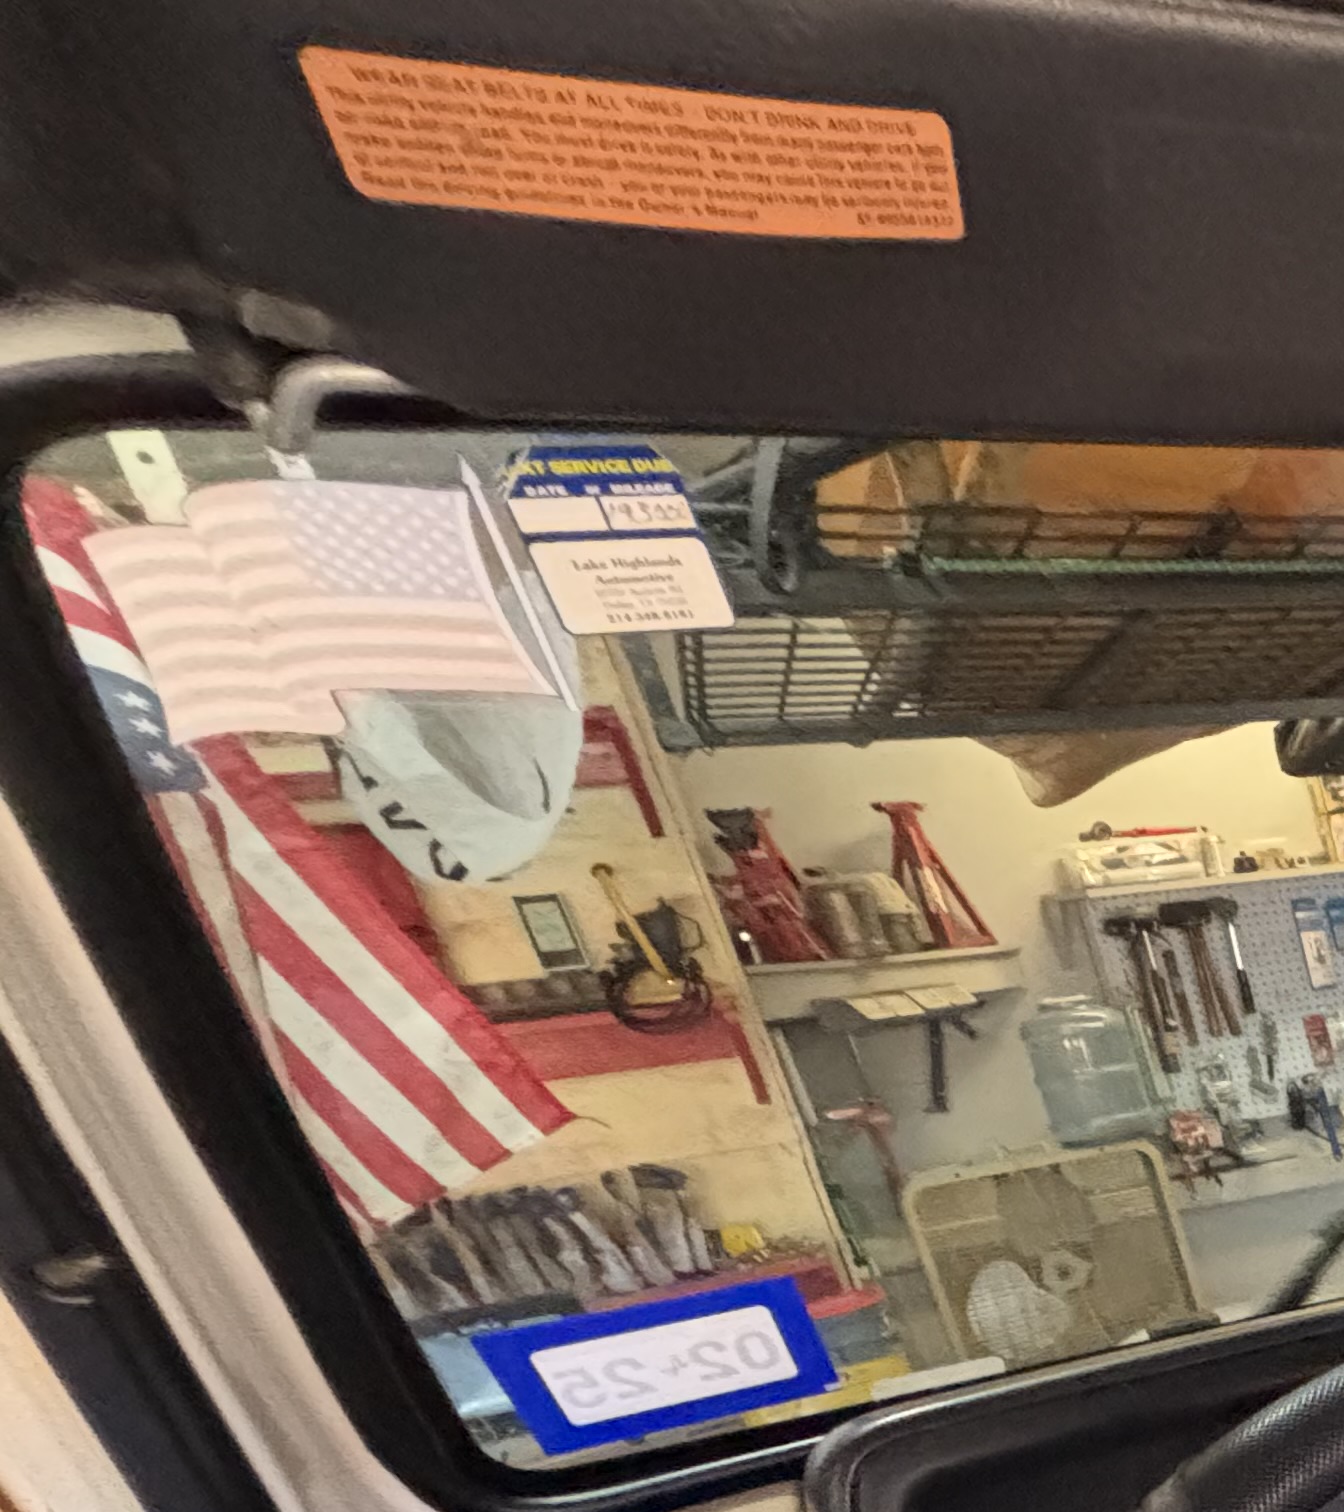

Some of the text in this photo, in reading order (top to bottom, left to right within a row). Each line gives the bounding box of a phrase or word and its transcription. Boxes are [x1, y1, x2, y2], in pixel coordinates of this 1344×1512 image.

[350, 68, 418, 88] WEAR
[421, 74, 477, 94] SEAT
[480, 79, 548, 104] BELTS
[553, 88, 577, 105] AT
[586, 92, 622, 112] ALL
[624, 96, 684, 117] TIMES
[764, 111, 821, 132] DRINK
[826, 117, 864, 134] AND
[865, 120, 916, 137] DRIVE
[548, 458, 632, 475] SERVICE
[630, 457, 675, 473] DUE
[522, 485, 568, 497] DATE
[609, 482, 677, 495] MILEAGE
[570, 555, 683, 571] Lake Highlands
[595, 574, 674, 584] Automotive
